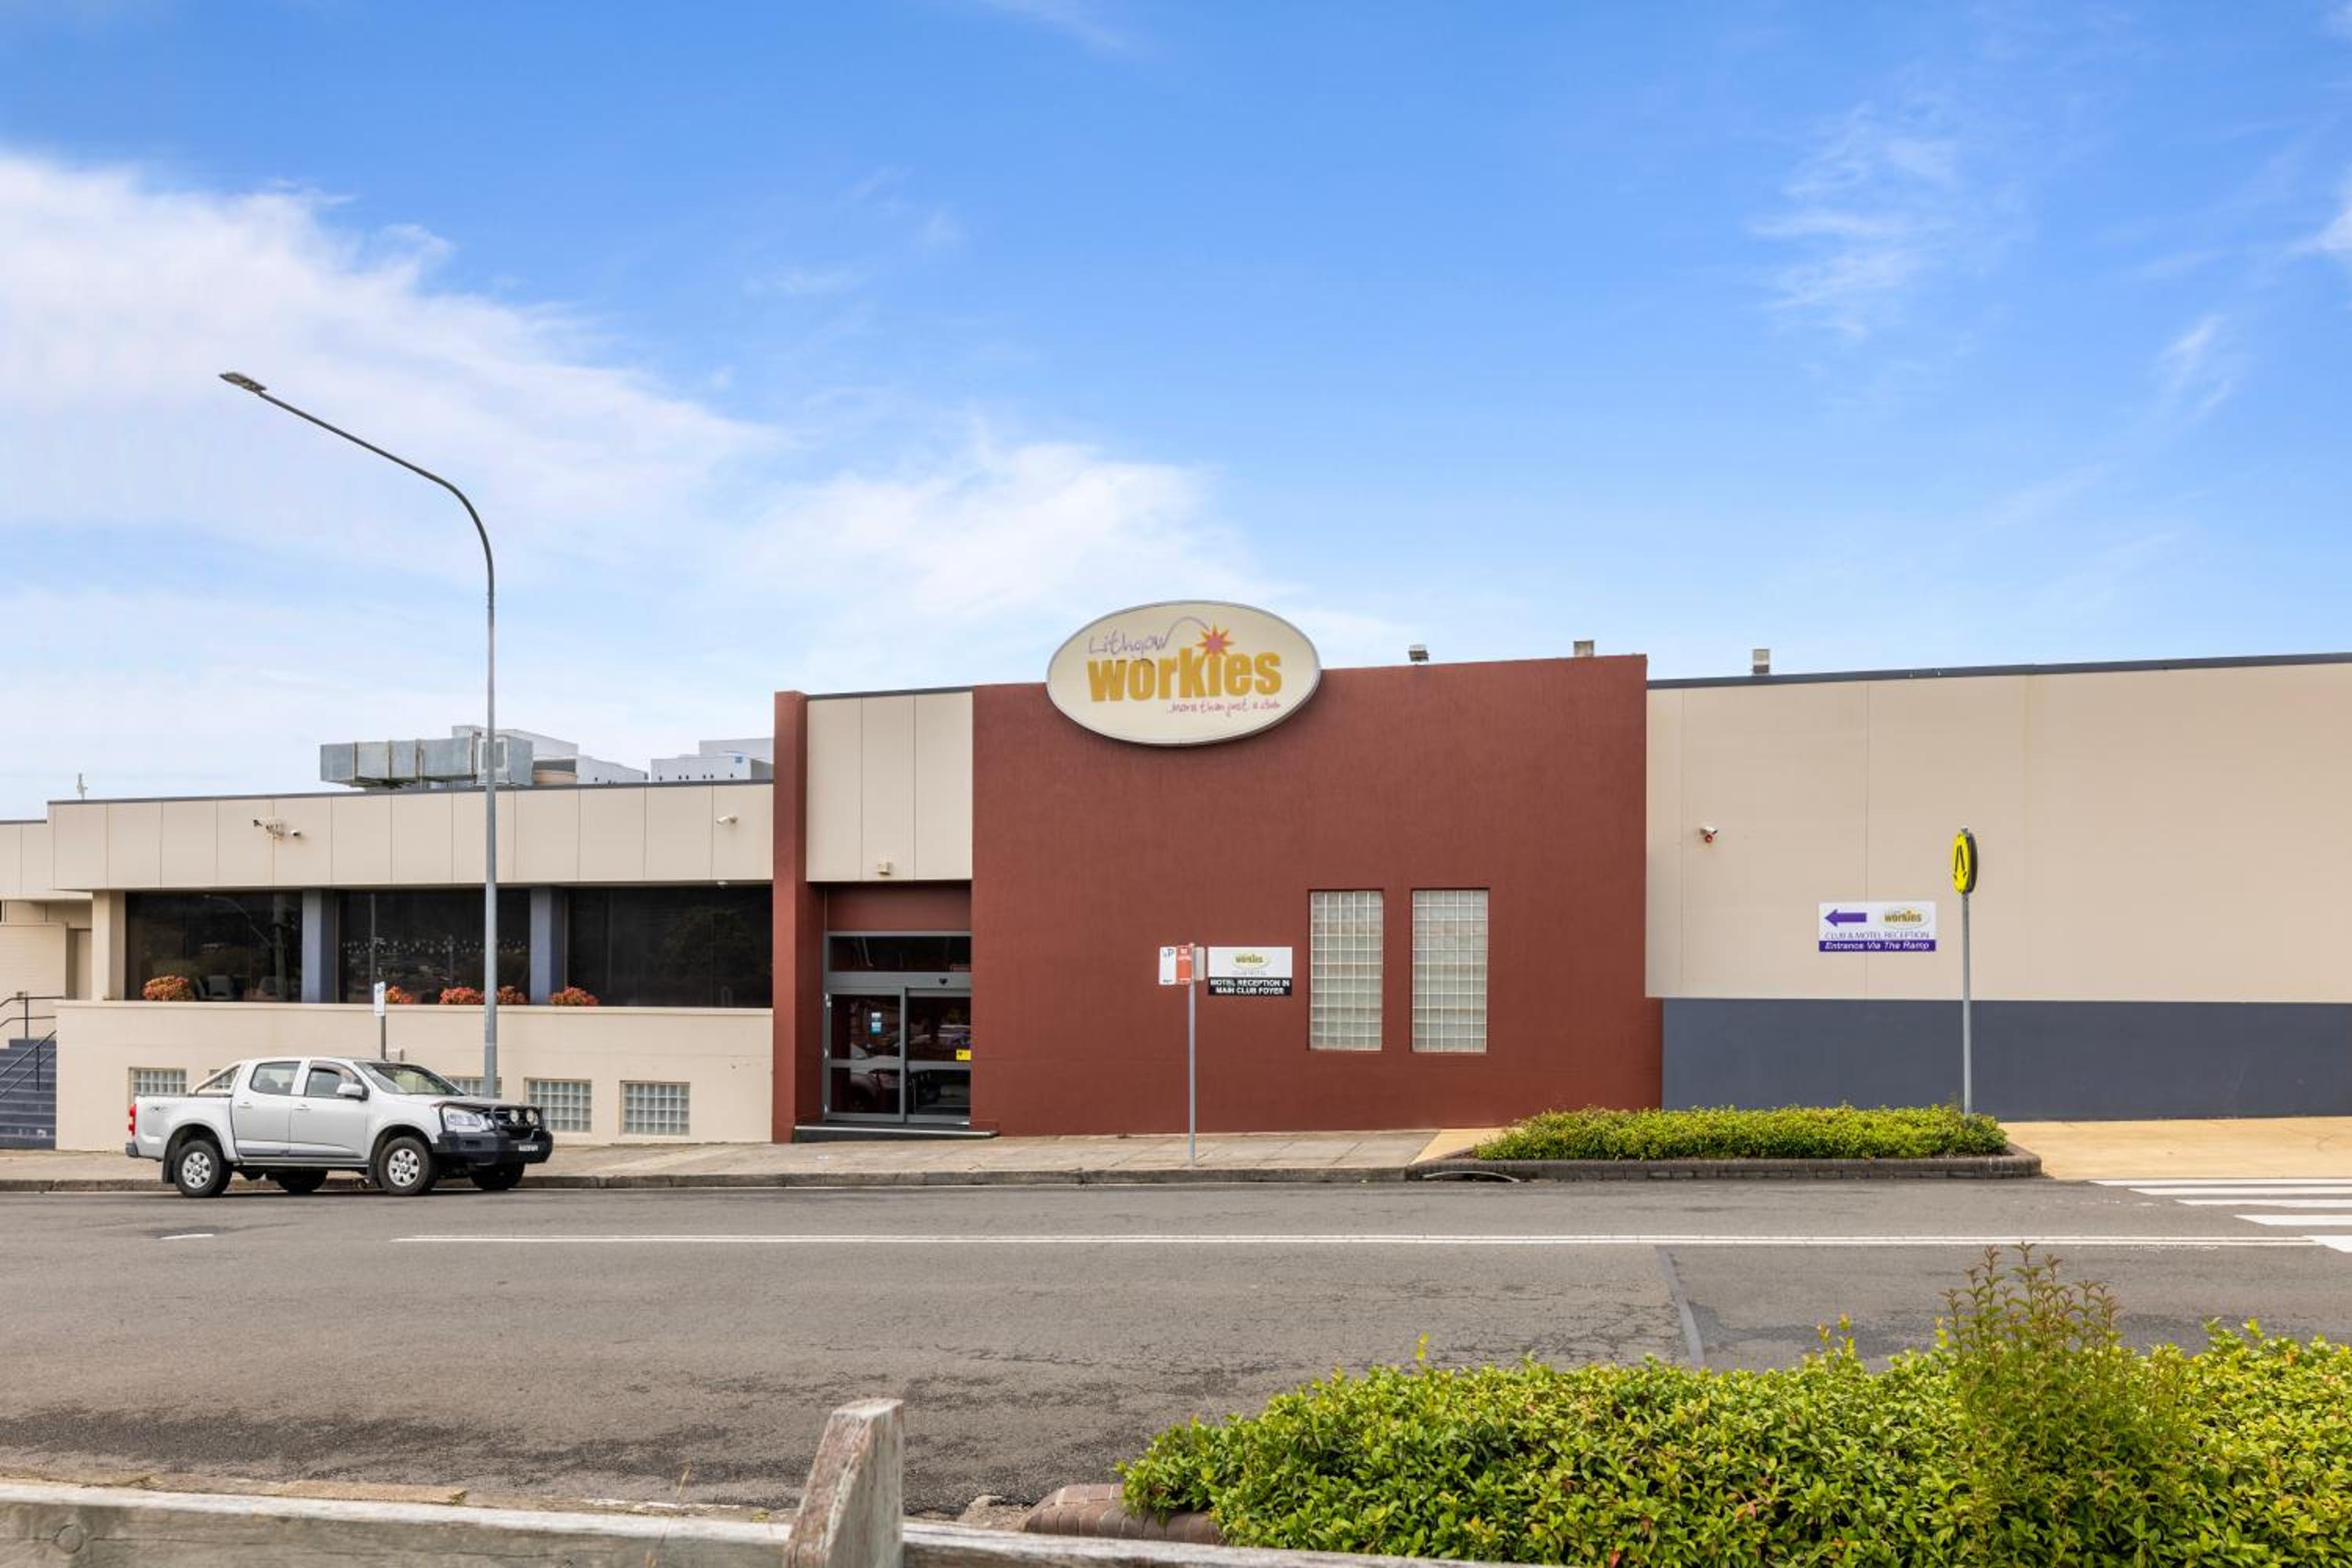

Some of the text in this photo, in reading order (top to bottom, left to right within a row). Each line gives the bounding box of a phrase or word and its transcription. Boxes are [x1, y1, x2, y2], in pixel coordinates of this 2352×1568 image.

[1088, 630, 1169, 655] Lithgow
[1087, 648, 1282, 702] workies
[1200, 699, 1224, 713] than
[1225, 697, 1248, 717] just
[1260, 699, 1280, 709] club
[1884, 913, 1922, 923] workies
[1855, 931, 1881, 939] MOTEL
[1903, 941, 1929, 949] Ramp
